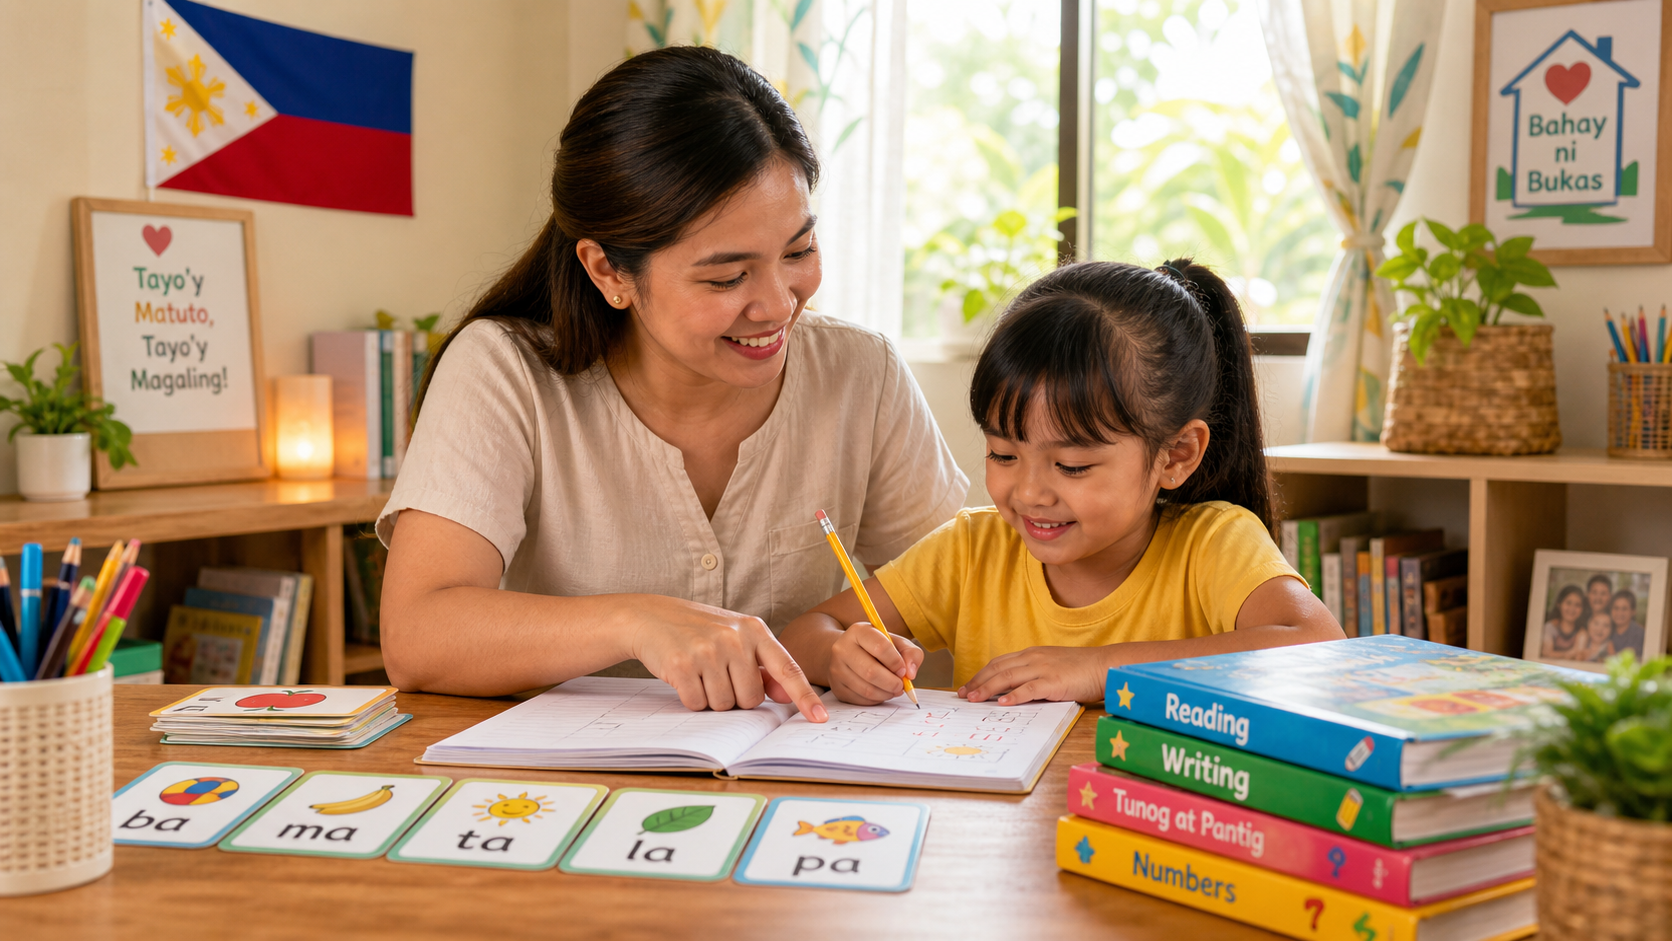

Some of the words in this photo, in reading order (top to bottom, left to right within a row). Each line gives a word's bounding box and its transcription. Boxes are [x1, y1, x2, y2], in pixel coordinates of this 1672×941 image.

[1529, 111, 1607, 140] Bahay
[1555, 140, 1576, 163] ni
[1528, 168, 1602, 192] Bukas
[133, 266, 204, 296] Tayo'y
[135, 301, 215, 328] Matuto,
[142, 334, 208, 363] Tayo'y
[131, 366, 228, 396] Magaling!
[1165, 692, 1250, 746] Reading
[1162, 743, 1250, 800] Writing
[119, 809, 190, 832] ba
[277, 822, 358, 842] ma
[1113, 787, 1171, 832] Tunog
[1174, 810, 1196, 834] at
[1201, 809, 1265, 858] Pantig
[457, 829, 514, 852] ta
[627, 839, 676, 863] la
[792, 855, 861, 876] pa
[1133, 851, 1236, 904] Numbers
